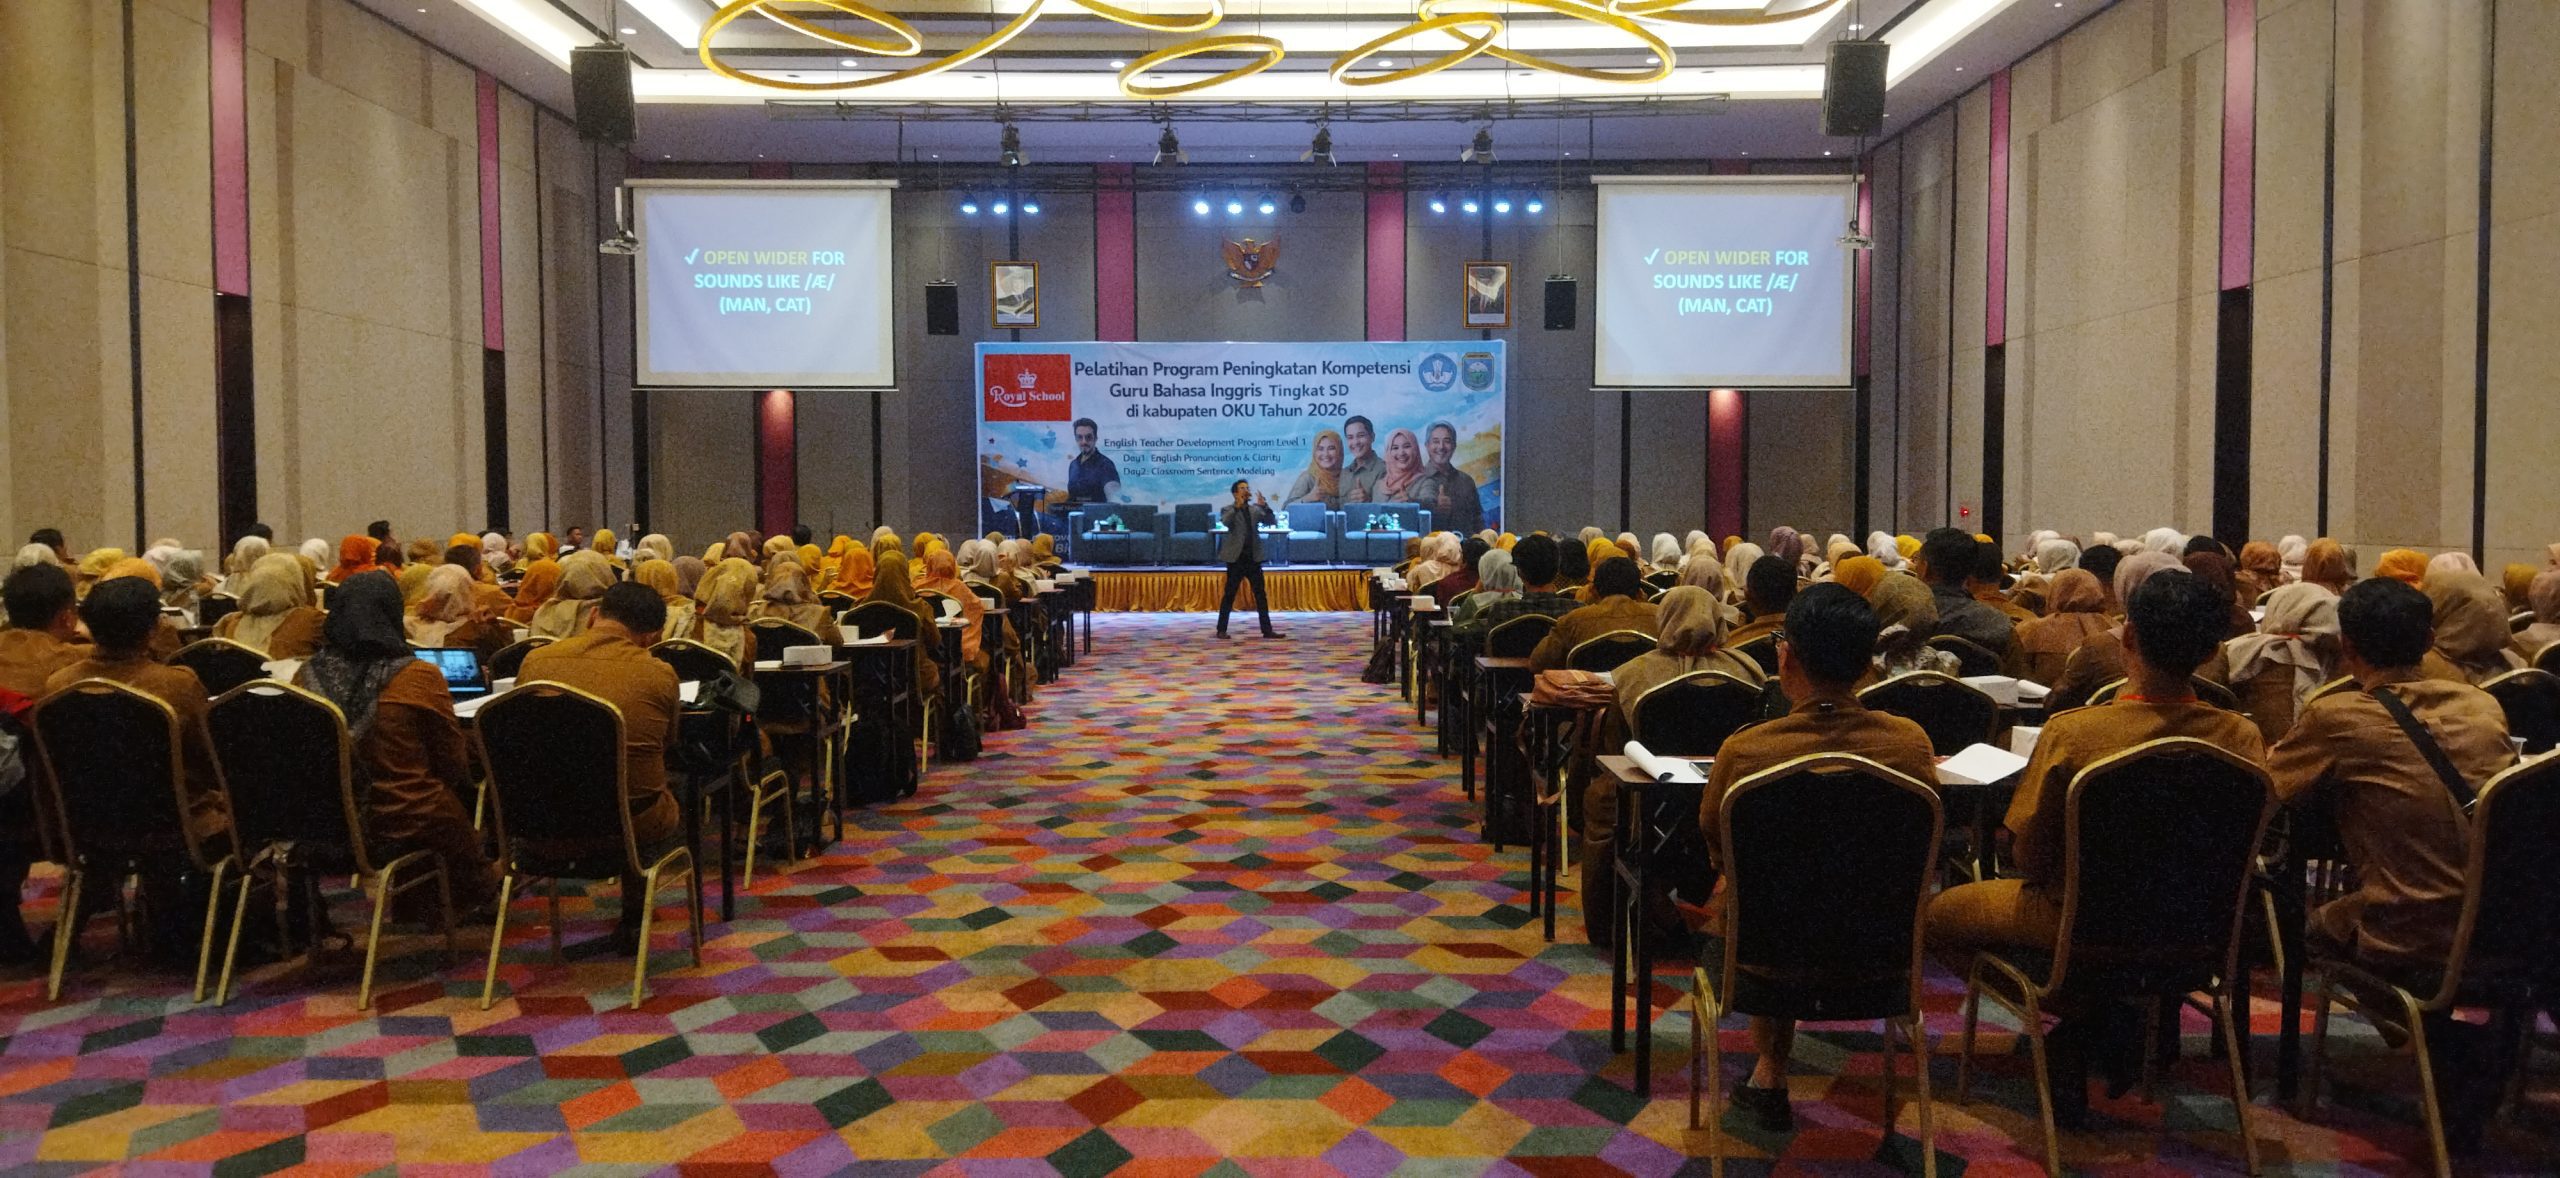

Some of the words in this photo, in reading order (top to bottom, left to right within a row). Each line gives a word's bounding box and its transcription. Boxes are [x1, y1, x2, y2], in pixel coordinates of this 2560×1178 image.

[703, 251, 749, 265] OPEN
[753, 251, 808, 265] WIDER
[812, 251, 845, 266] FOR
[1664, 251, 1709, 265] OPEN
[1715, 251, 1770, 265] WIDER
[1775, 251, 1809, 266] FOR
[694, 274, 763, 289] SOUNDS
[767, 274, 800, 288] LIKE
[1653, 274, 1724, 289] SOUNDS
[1728, 274, 1762, 289] LIKE
[720, 297, 771, 315] (MAN,
[775, 297, 812, 315] CAT)
[1678, 298, 1731, 316] (MAN,
[1736, 298, 1773, 316] CAT)
[1074, 361, 1148, 376] Pelatihan
[1153, 361, 1218, 379] Program
[1223, 361, 1317, 378] Peningkatan
[1322, 360, 1411, 377] Kompetensi
[990, 385, 1027, 407] Royal
[1029, 391, 1065, 401] School
[1110, 383, 1149, 398] Guru
[1153, 383, 1207, 398] Bahasa
[1211, 383, 1262, 400] Inggris
[1269, 385, 1324, 400] Tingkat
[1329, 384, 1349, 397] SD
[1126, 404, 1139, 417] di
[1143, 404, 1217, 420] kabupaten
[1222, 404, 1255, 417] OKU
[1259, 404, 1302, 417] Tahun
[1308, 403, 1348, 417] 2026
[1104, 437, 1137, 449] English
[1140, 438, 1174, 448] Teacher
[1176, 438, 1234, 448] Development
[1237, 438, 1274, 448] Program
[1276, 437, 1299, 447] Level
[1302, 438, 1306, 446] 1
[1151, 454, 1182, 463] English
[1184, 453, 1242, 462] Pronunciation
[1244, 454, 1250, 462] &
[1252, 453, 1281, 463] Clarity
[1151, 467, 1195, 476] Classroom
[1197, 467, 1235, 475] Sentence
[1237, 466, 1275, 477] Modeling
